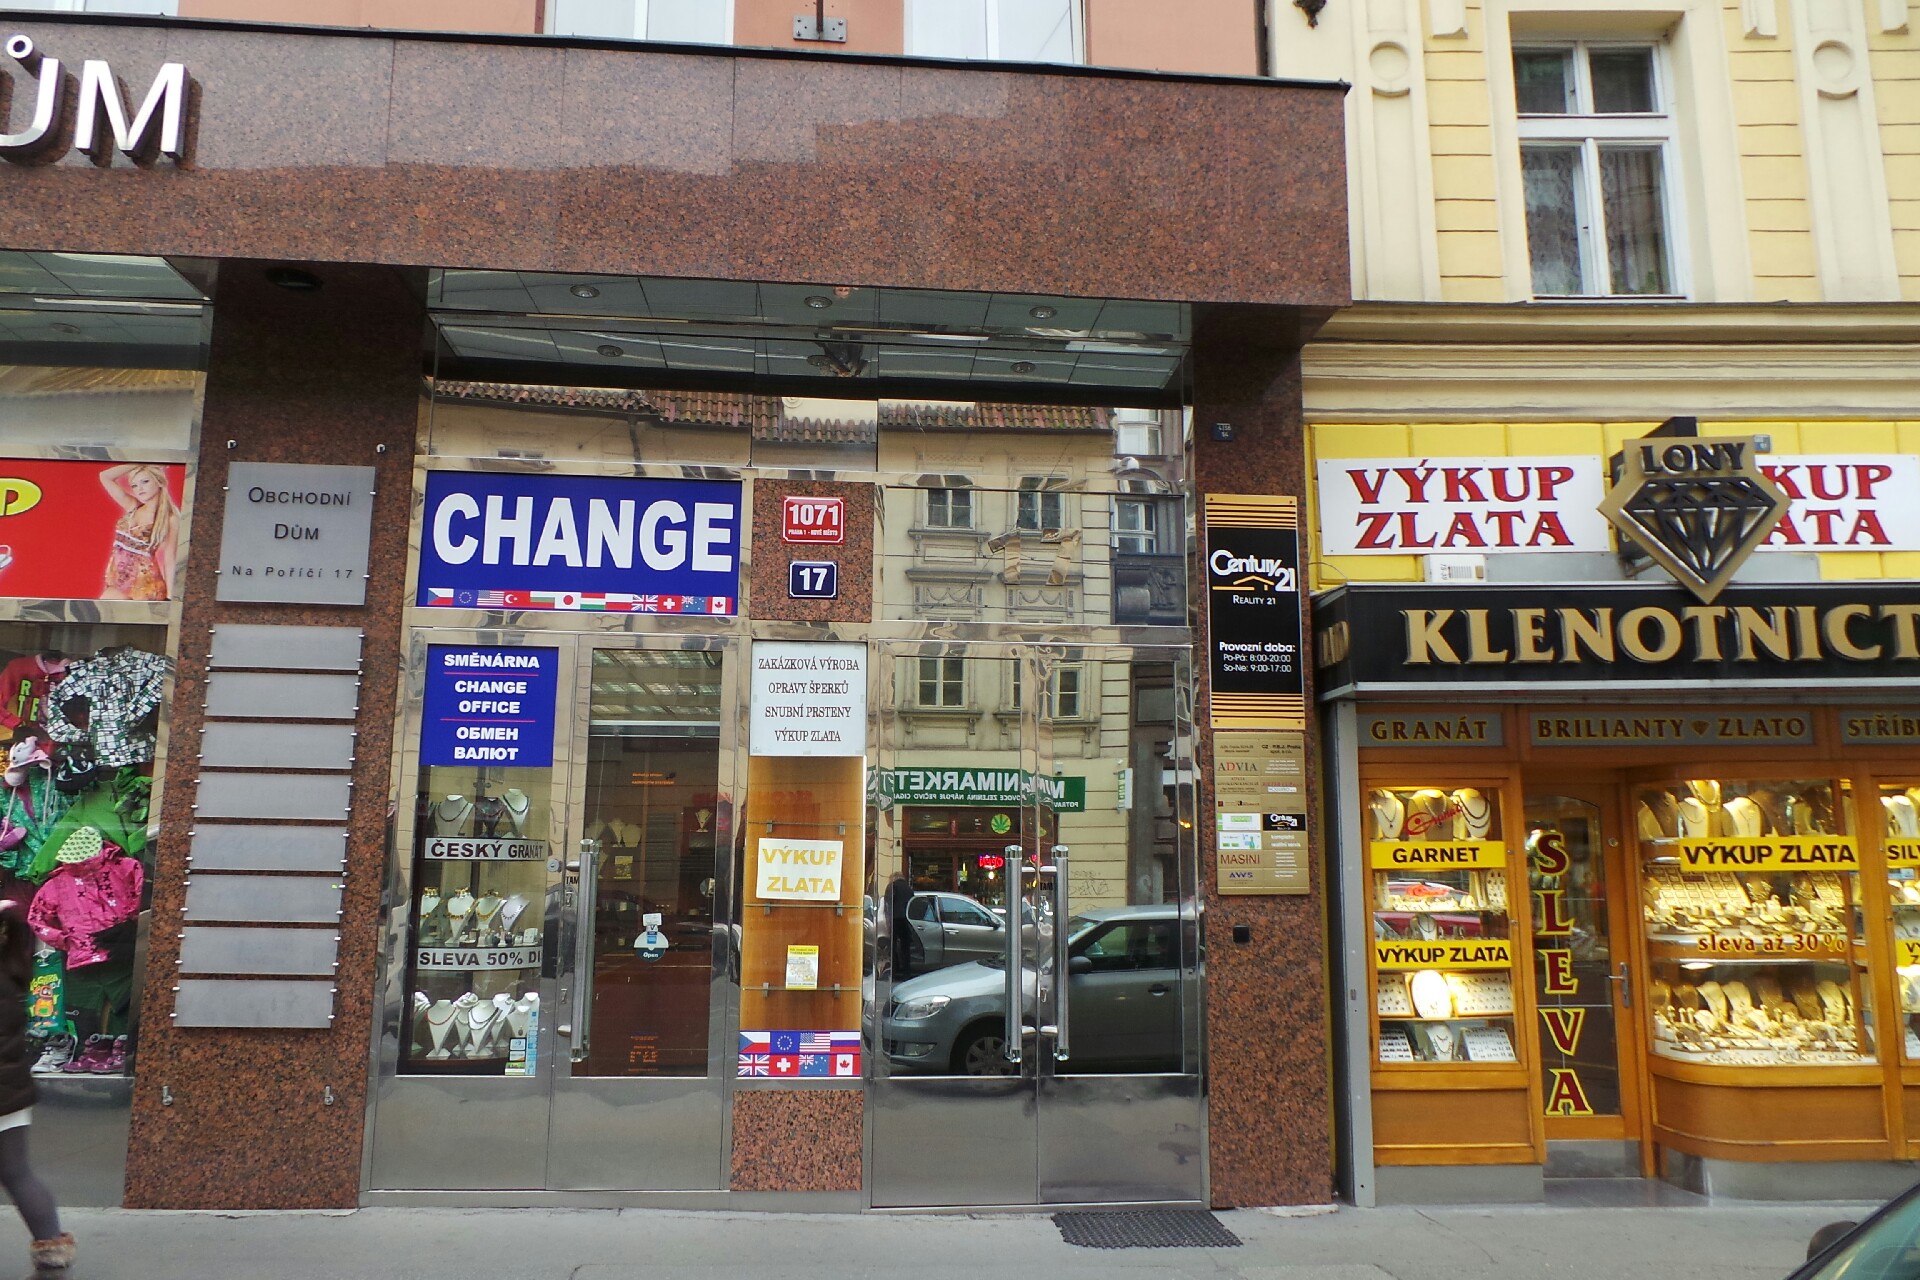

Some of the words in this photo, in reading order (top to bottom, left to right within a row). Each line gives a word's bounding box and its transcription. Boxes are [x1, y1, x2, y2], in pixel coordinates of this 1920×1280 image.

[1640, 442, 1746, 473] LONY
[1345, 458, 1575, 504] VÝKUP
[788, 504, 839, 526] 1071
[432, 492, 734, 572] CHANGE
[1354, 510, 1575, 550] ZLATA
[232, 566, 253, 576] Na
[265, 566, 323, 578] Poříčí
[334, 569, 353, 579] 17
[799, 567, 828, 591] 17
[1210, 549, 1282, 577] Century
[1274, 568, 1296, 592] 21
[1219, 641, 1262, 652] Provozní
[1264, 642, 1296, 652] doba:
[444, 652, 540, 668] SMĚNÁRNA
[758, 656, 817, 670] ZAKÁZKOVÁ
[819, 656, 860, 670] VÝROBA
[1223, 653, 1248, 662] Po-Pá:
[1249, 654, 1292, 662] 8:00-20:00
[1223, 663, 1249, 672] So-Ne:
[1250, 664, 1292, 673] 9:00-17:00
[454, 680, 528, 694] CHANGE
[768, 682, 807, 694] OPRAVY
[809, 680, 849, 694] ŠPERKŮ
[458, 700, 521, 714] OFFICE
[765, 703, 804, 717] SNUBNÍ
[806, 706, 852, 718] PRSTENY
[456, 727, 519, 740] ОБМЕН
[774, 727, 809, 741] VÝKUP
[810, 730, 842, 741] ZLATA
[1371, 716, 1488, 740] GRANÁT
[1537, 718, 1684, 739] BRILIANTY
[1717, 718, 1806, 738] ZLATO
[1847, 714, 1920, 738] STŘÍB
[454, 746, 519, 760] ВАЛЮТ
[1217, 762, 1258, 772] ADVIA
[431, 838, 503, 858] ČESKÝ
[762, 845, 837, 866] VÝKUP
[1392, 847, 1480, 863] GARNET
[1683, 842, 1773, 864] VÝKUP
[1779, 844, 1856, 863] ZLATA
[1220, 854, 1260, 865] MASINI
[767, 876, 836, 894] ZLATA
[1698, 933, 1756, 951] sleva
[1763, 933, 1784, 951] až
[419, 951, 480, 966] SLEVA
[486, 951, 523, 967] 50%
[1377, 945, 1445, 963] VÝKUP
[1450, 946, 1509, 962] ZLATA
[1532, 833, 1594, 1116] SLEVA
